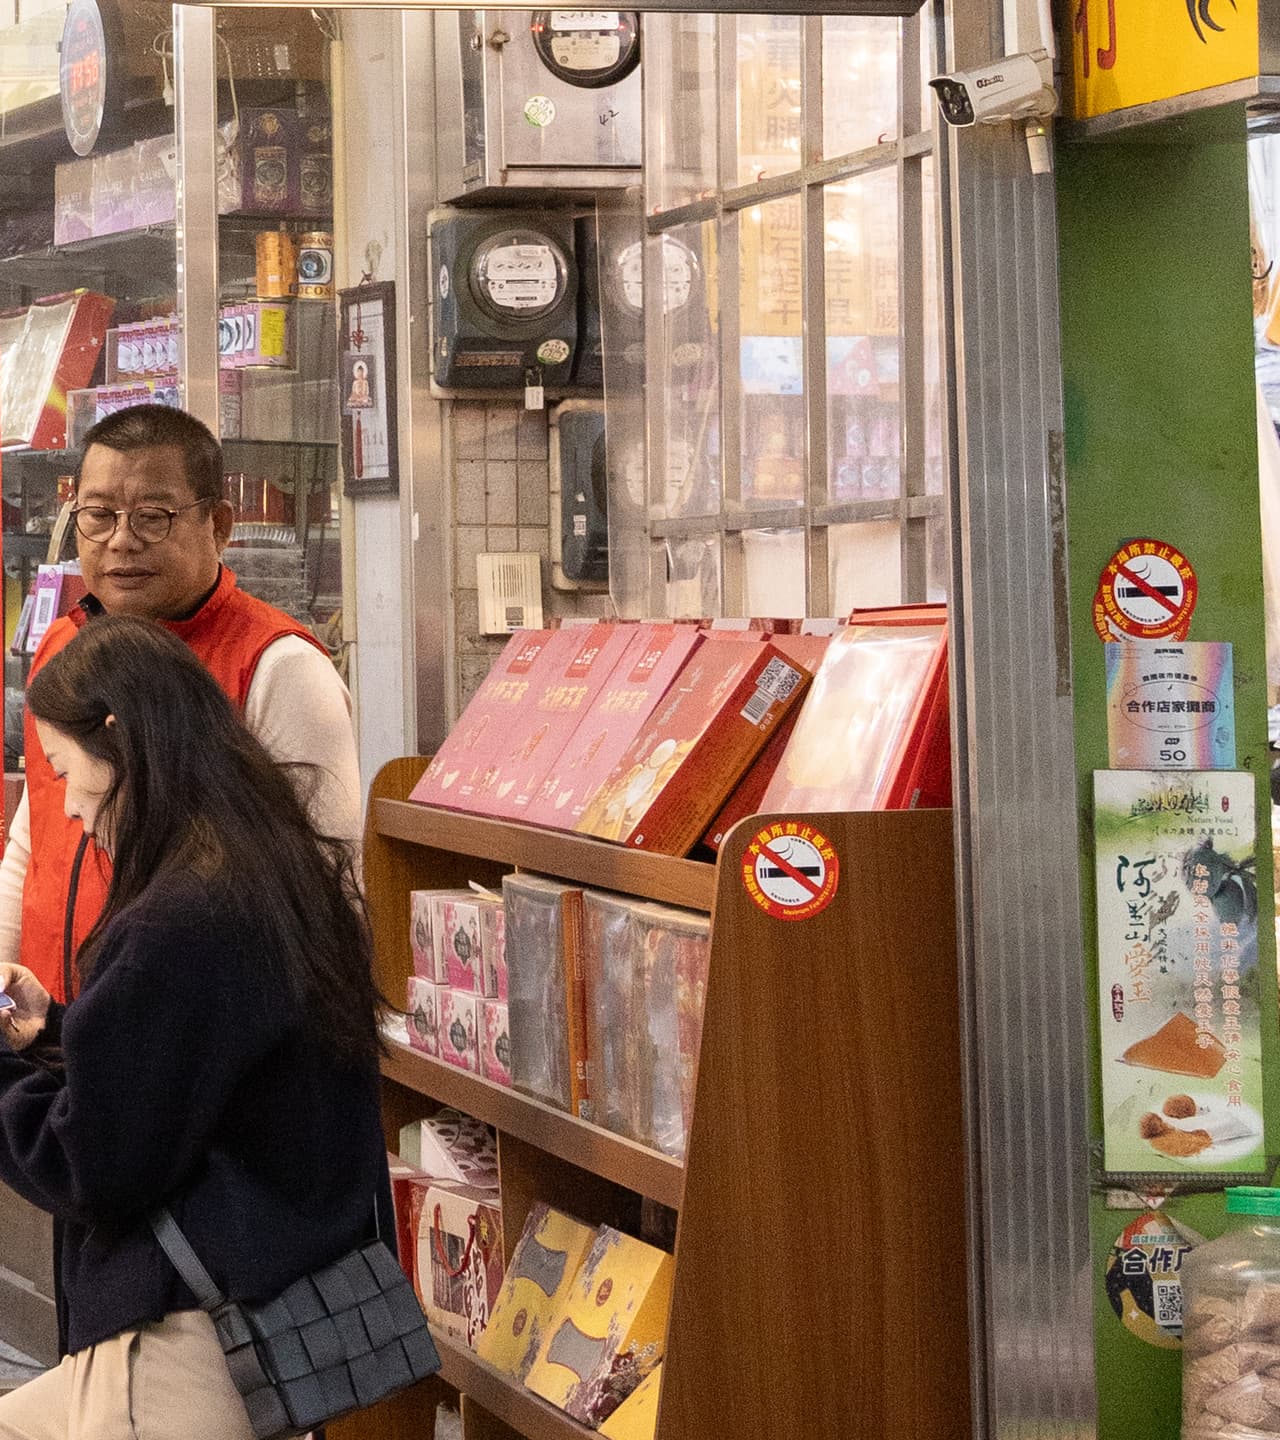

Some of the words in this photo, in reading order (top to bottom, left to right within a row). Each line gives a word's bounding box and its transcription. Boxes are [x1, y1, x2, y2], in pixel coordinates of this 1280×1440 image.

[1107, 541, 1194, 579] 本場所禁止吸菸
[1125, 699, 1216, 714] 合作店家攤商
[1159, 749, 1187, 762] 50
[748, 823, 835, 861] 本場所禁止吸菸
